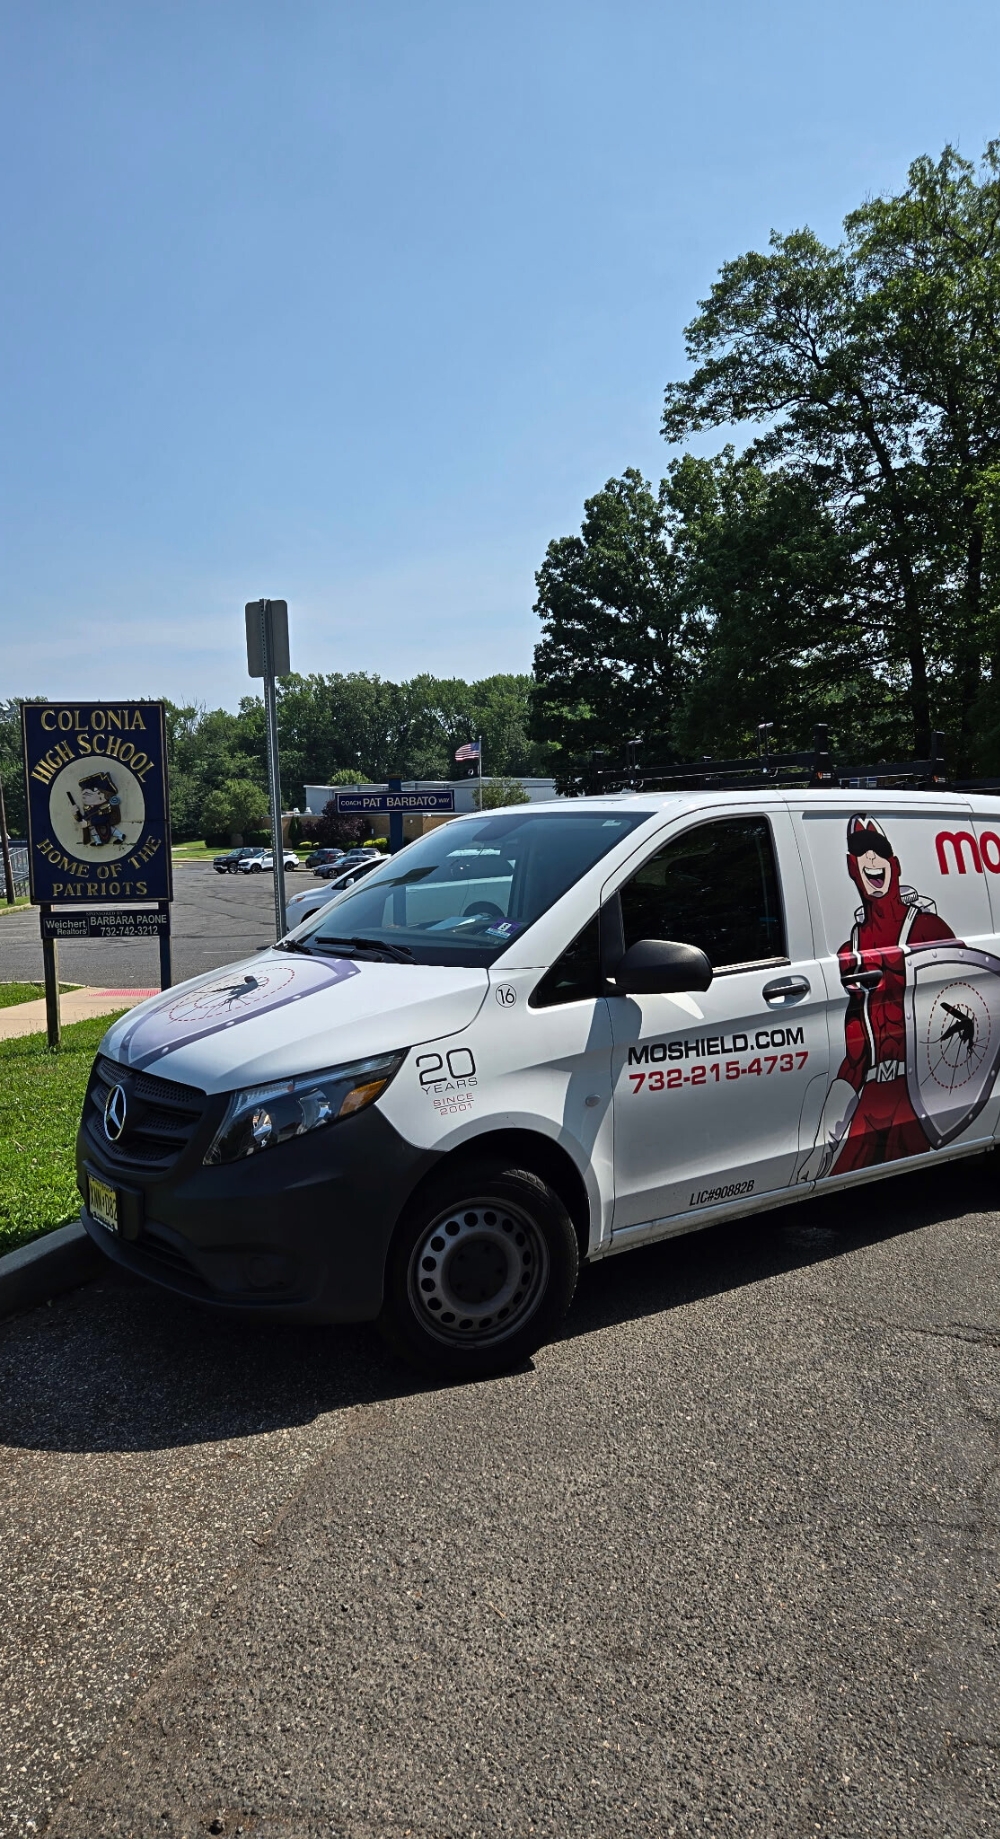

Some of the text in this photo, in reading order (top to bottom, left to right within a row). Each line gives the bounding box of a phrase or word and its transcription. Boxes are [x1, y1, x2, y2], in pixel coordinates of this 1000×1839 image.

[40, 709, 147, 731] COLONIA
[31, 733, 155, 785] HIGH SCHOOL
[340, 799, 362, 807] COACH
[362, 797, 382, 808] PAT
[386, 795, 437, 807] BARBATO
[36, 835, 162, 879] HOME OF THE
[52, 881, 148, 897] PATRIOTS
[90, 914, 168, 926] BARBARA PAONE
[100, 925, 159, 937] 732-742-3212
[498, 988, 515, 1005] 16
[627, 1026, 805, 1066] MOSHIELD.COM
[415, 1047, 476, 1086] 20
[628, 1051, 809, 1095] 732-215-4737
[421, 1076, 478, 1096] YEARS
[432, 1092, 474, 1108] SINCE
[439, 1102, 473, 1116] 2001
[689, 1180, 755, 1207] LIC#90882B
